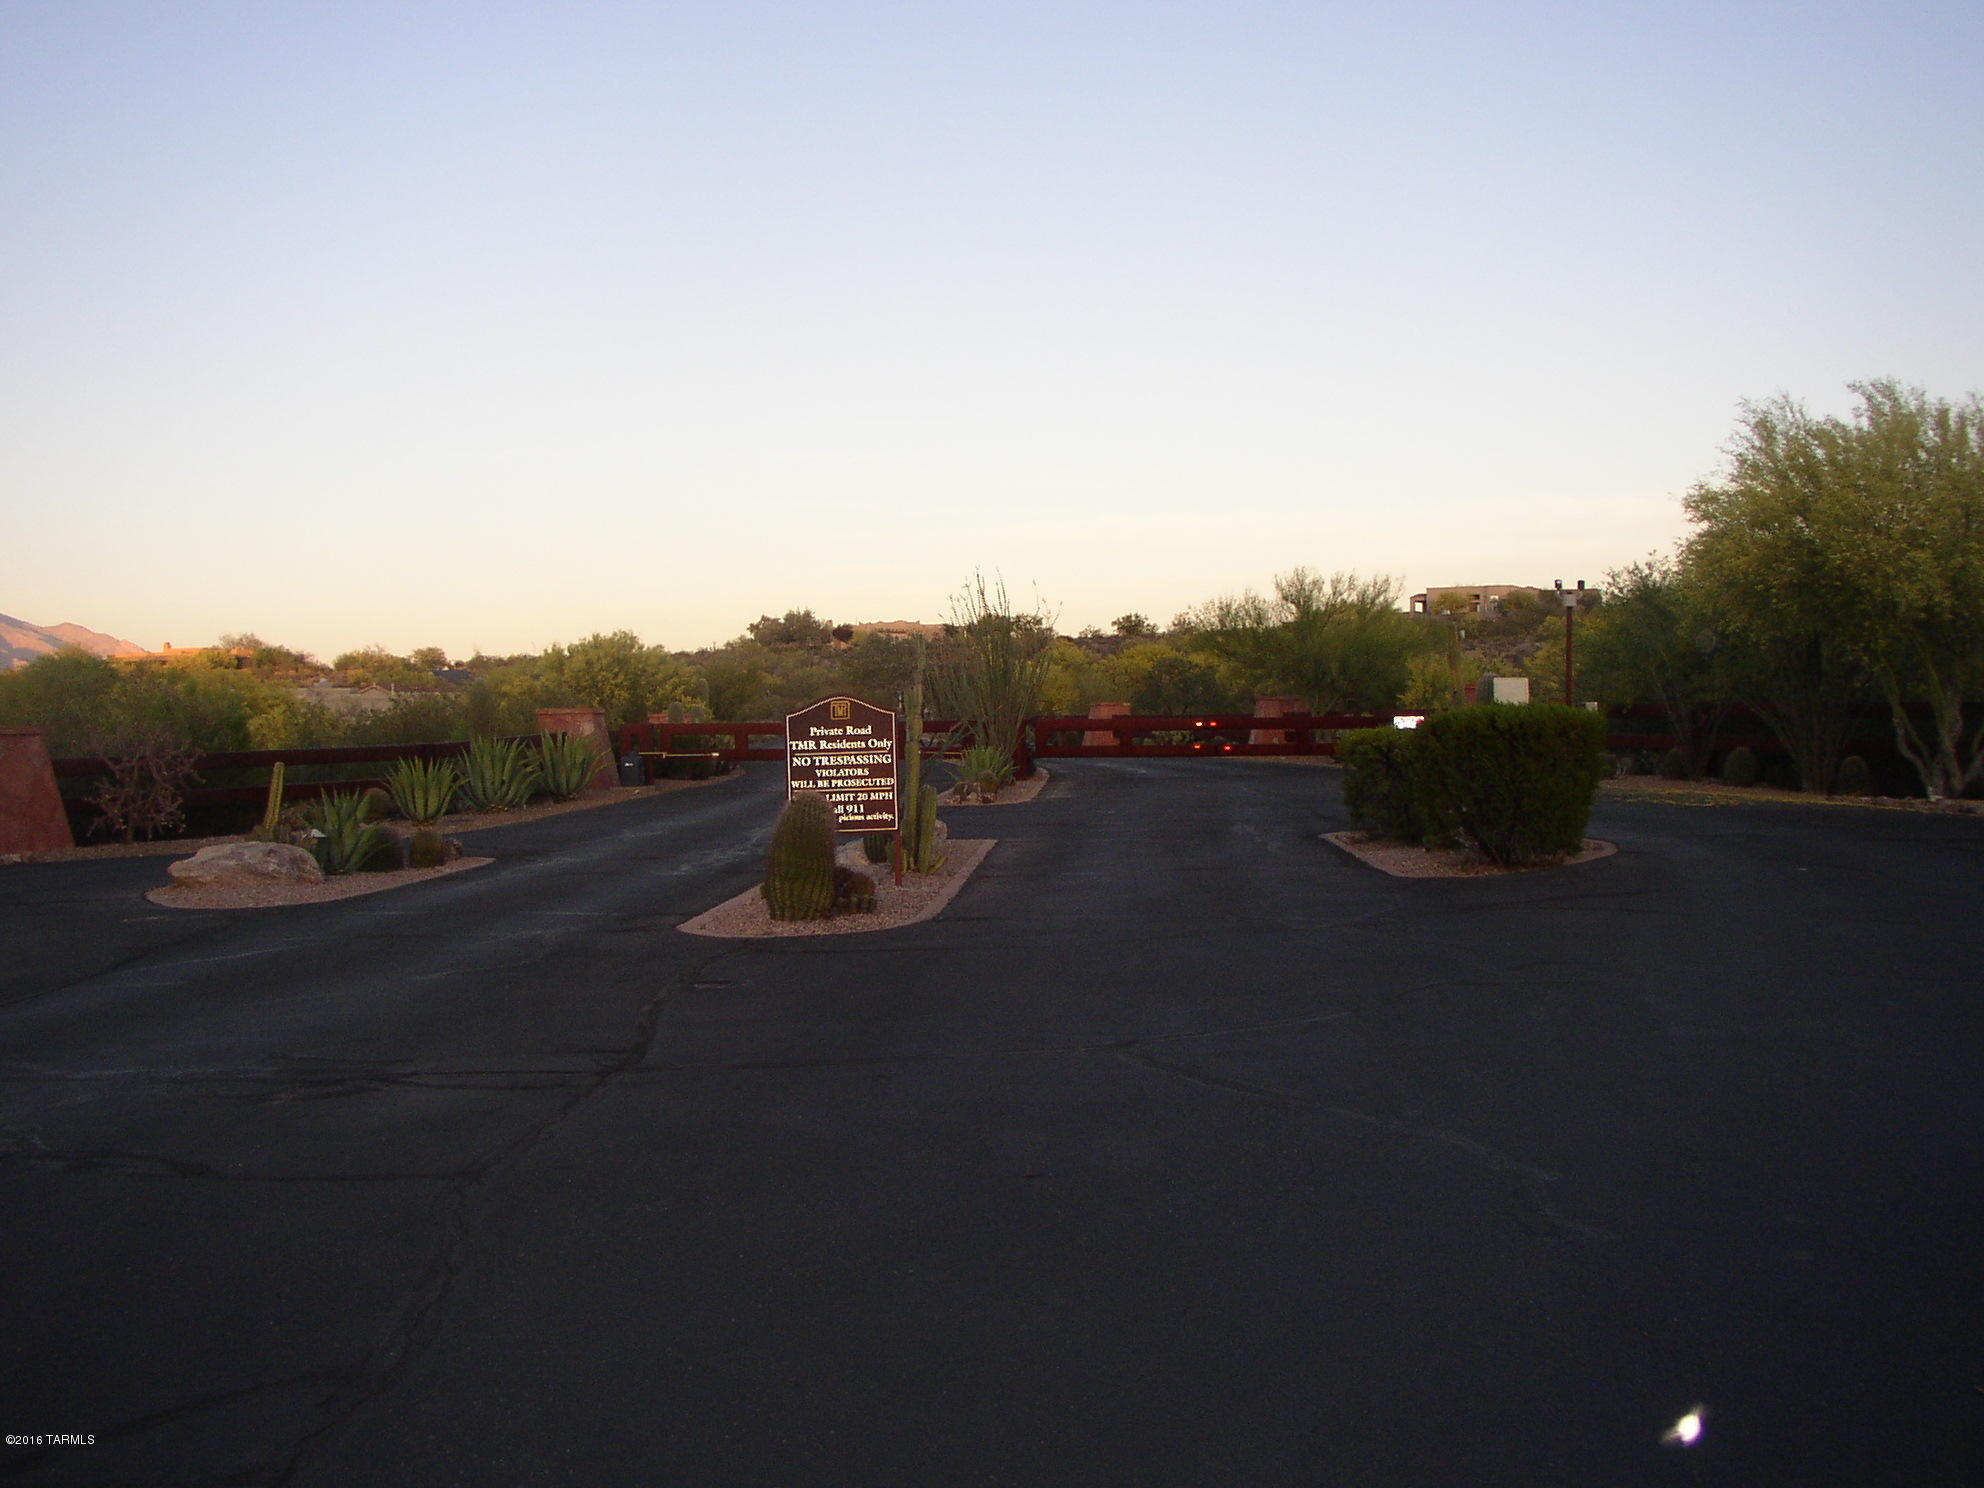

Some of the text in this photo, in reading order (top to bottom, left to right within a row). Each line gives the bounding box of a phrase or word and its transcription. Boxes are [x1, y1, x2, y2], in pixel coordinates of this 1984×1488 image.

[810, 725, 872, 737] Private Road
[790, 738, 892, 750] TMR Residents Only
[792, 754, 892, 767] NO TRESPASSING
[815, 768, 869, 777] VIOLATORS
[791, 777, 895, 789] WILL BE PROSECUTED
[857, 793, 868, 801] 20
[870, 792, 893, 800] MPH
[846, 804, 864, 813] 911
